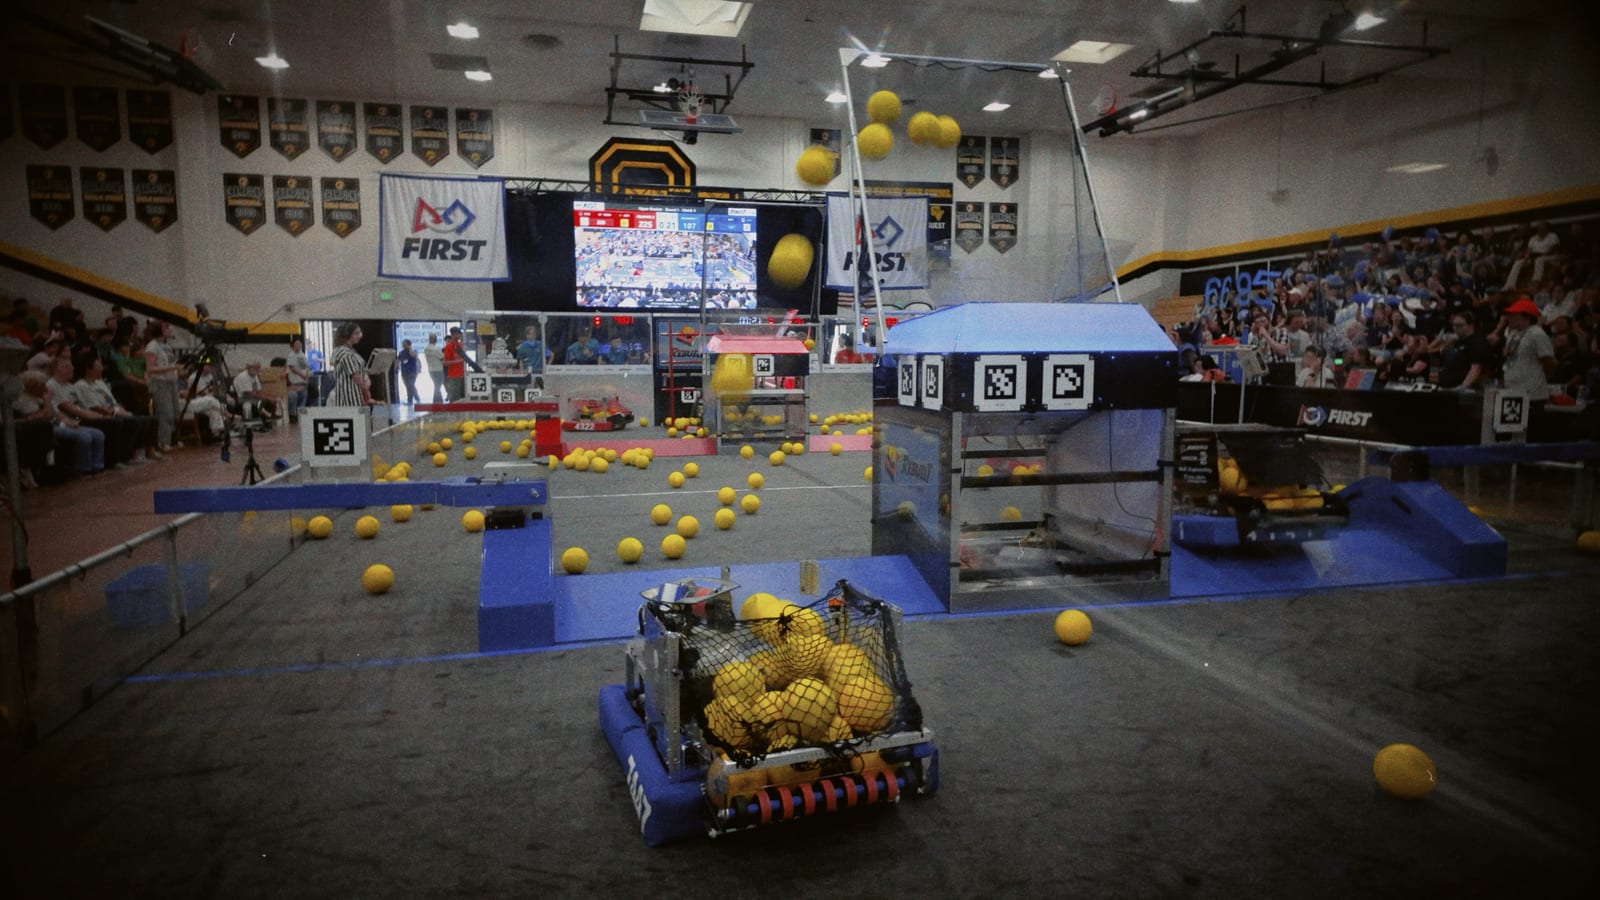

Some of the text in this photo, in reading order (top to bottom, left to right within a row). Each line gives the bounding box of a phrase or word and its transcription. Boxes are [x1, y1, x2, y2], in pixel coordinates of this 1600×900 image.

[683, 222, 696, 230] 107
[402, 238, 486, 261] FIRST
[843, 251, 909, 272] FRST
[574, 421, 595, 430] 4322
[1327, 409, 1373, 427] FIRST
